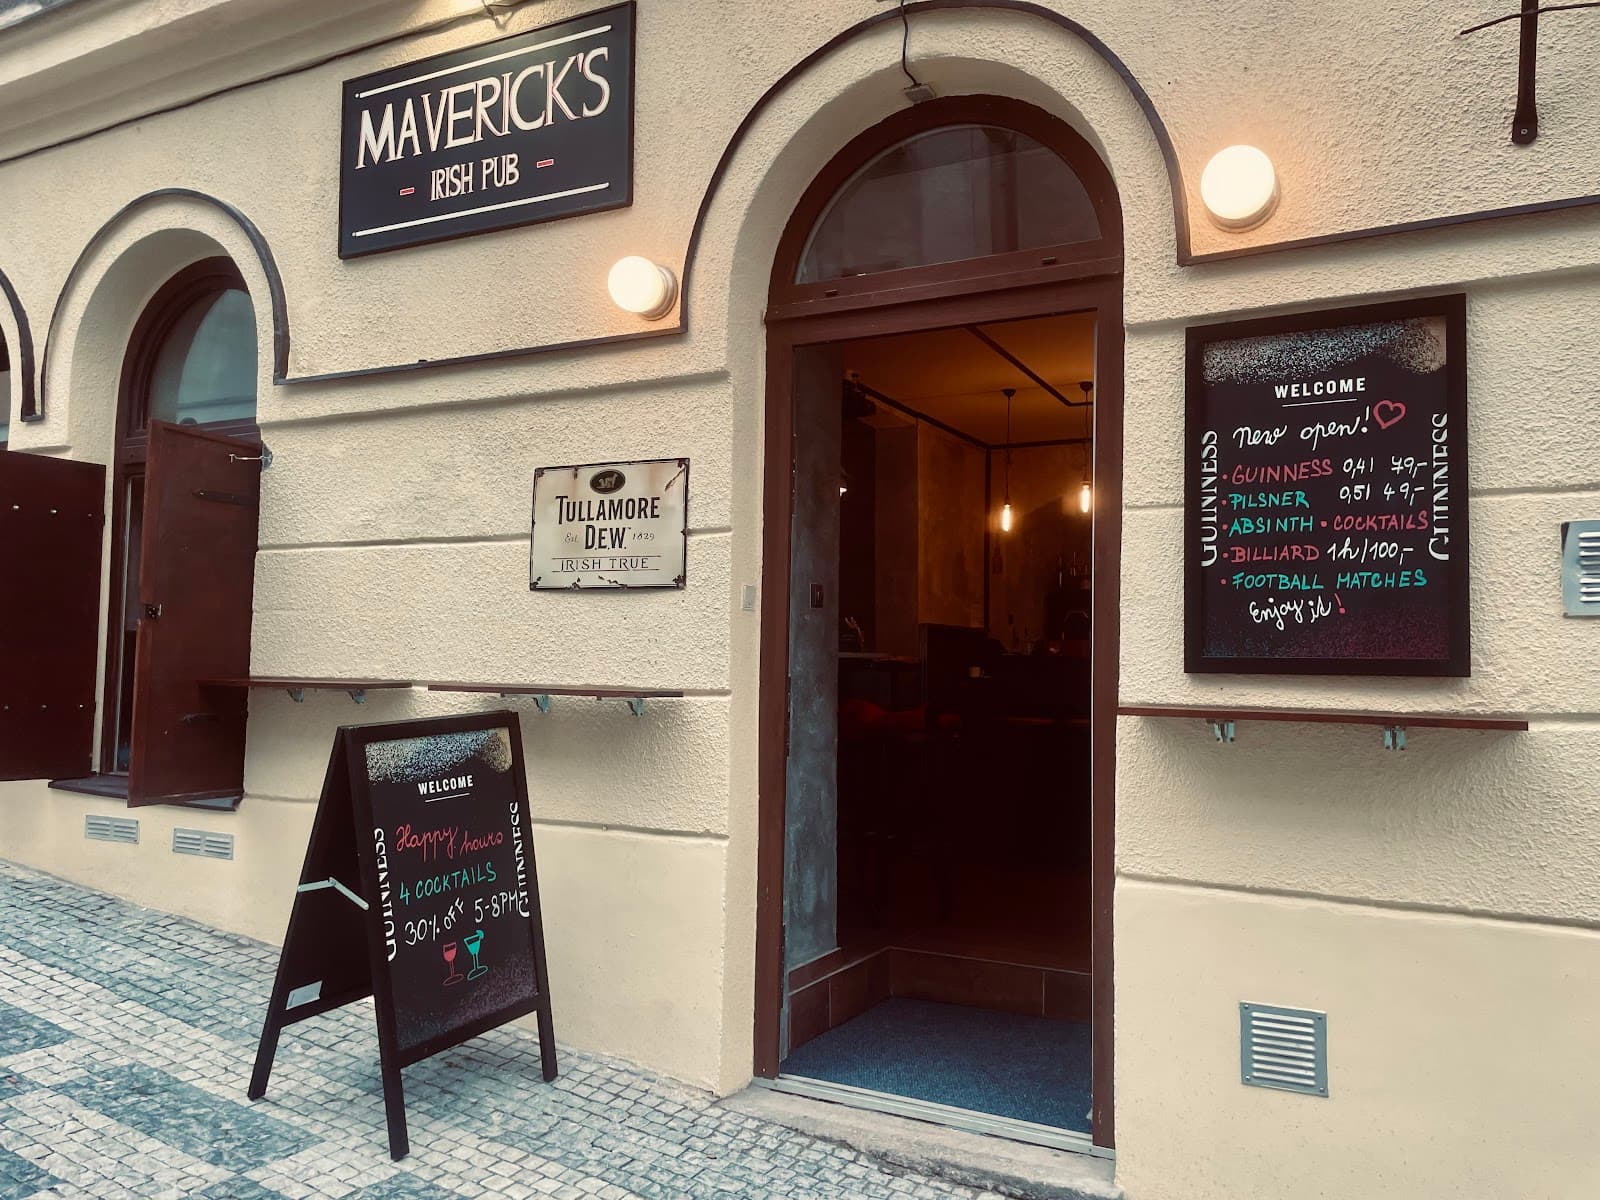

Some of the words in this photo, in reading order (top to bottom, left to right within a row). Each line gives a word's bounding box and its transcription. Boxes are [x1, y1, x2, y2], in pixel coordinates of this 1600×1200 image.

[355, 46, 610, 169] MAVERICK'S
[430, 162, 474, 201] IRISH
[481, 153, 520, 190] PUB
[1274, 377, 1366, 400] WELCOME
[1231, 458, 1334, 485] GUINNESS
[1228, 490, 1310, 510] PILSNER
[1228, 515, 1314, 537] ABSINTH
[1333, 510, 1429, 531] COCKTAILS
[561, 559, 601, 572] IRISH
[609, 557, 649, 570] TRUE
[1230, 544, 1320, 563] BILLIARD
[1232, 572, 1324, 590] FOOTBALL
[1336, 568, 1428, 590] MATCHES
[1249, 597, 1303, 630] Enjoy
[417, 775, 474, 796] WELCOME
[395, 823, 458, 863] Happy
[399, 881, 411, 905] 4
[415, 861, 497, 900] COCKTAILS
[404, 914, 441, 946] 30%
